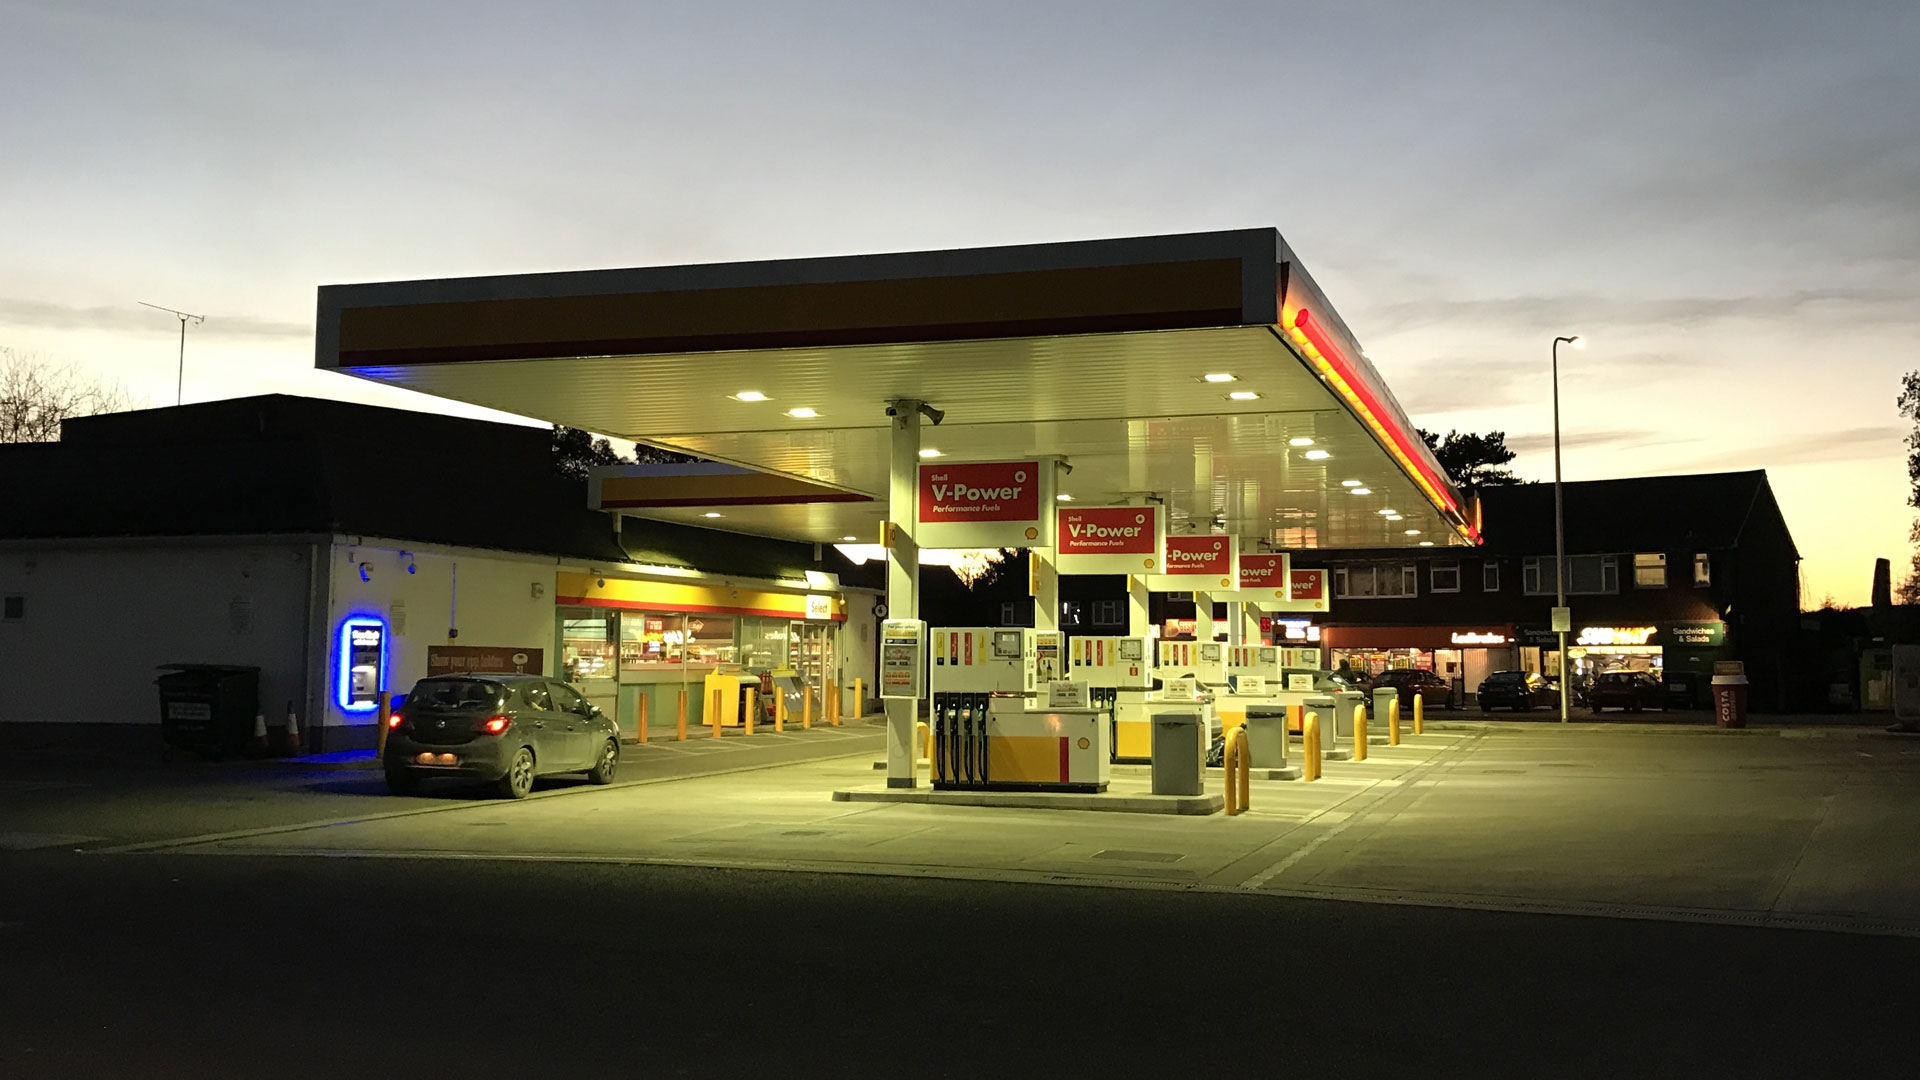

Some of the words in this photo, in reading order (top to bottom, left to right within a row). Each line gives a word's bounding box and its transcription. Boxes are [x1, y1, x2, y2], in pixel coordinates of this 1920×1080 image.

[931, 483, 1022, 501] V-Power
[932, 504, 980, 513] Performance
[981, 503, 1001, 512] Fuels
[1068, 523, 1142, 538] V-Power
[1069, 539, 1108, 547] Performance
[1108, 539, 1124, 547] Fuels
[1166, 549, 1219, 562] -Power
[1240, 567, 1274, 577] ower
[811, 600, 828, 614] Select
[1672, 627, 1715, 635] Sandwiches
[1451, 632, 1505, 644] Ladbrokes
[1686, 635, 1710, 643] Salads
[1720, 690, 1731, 722] COSTA
